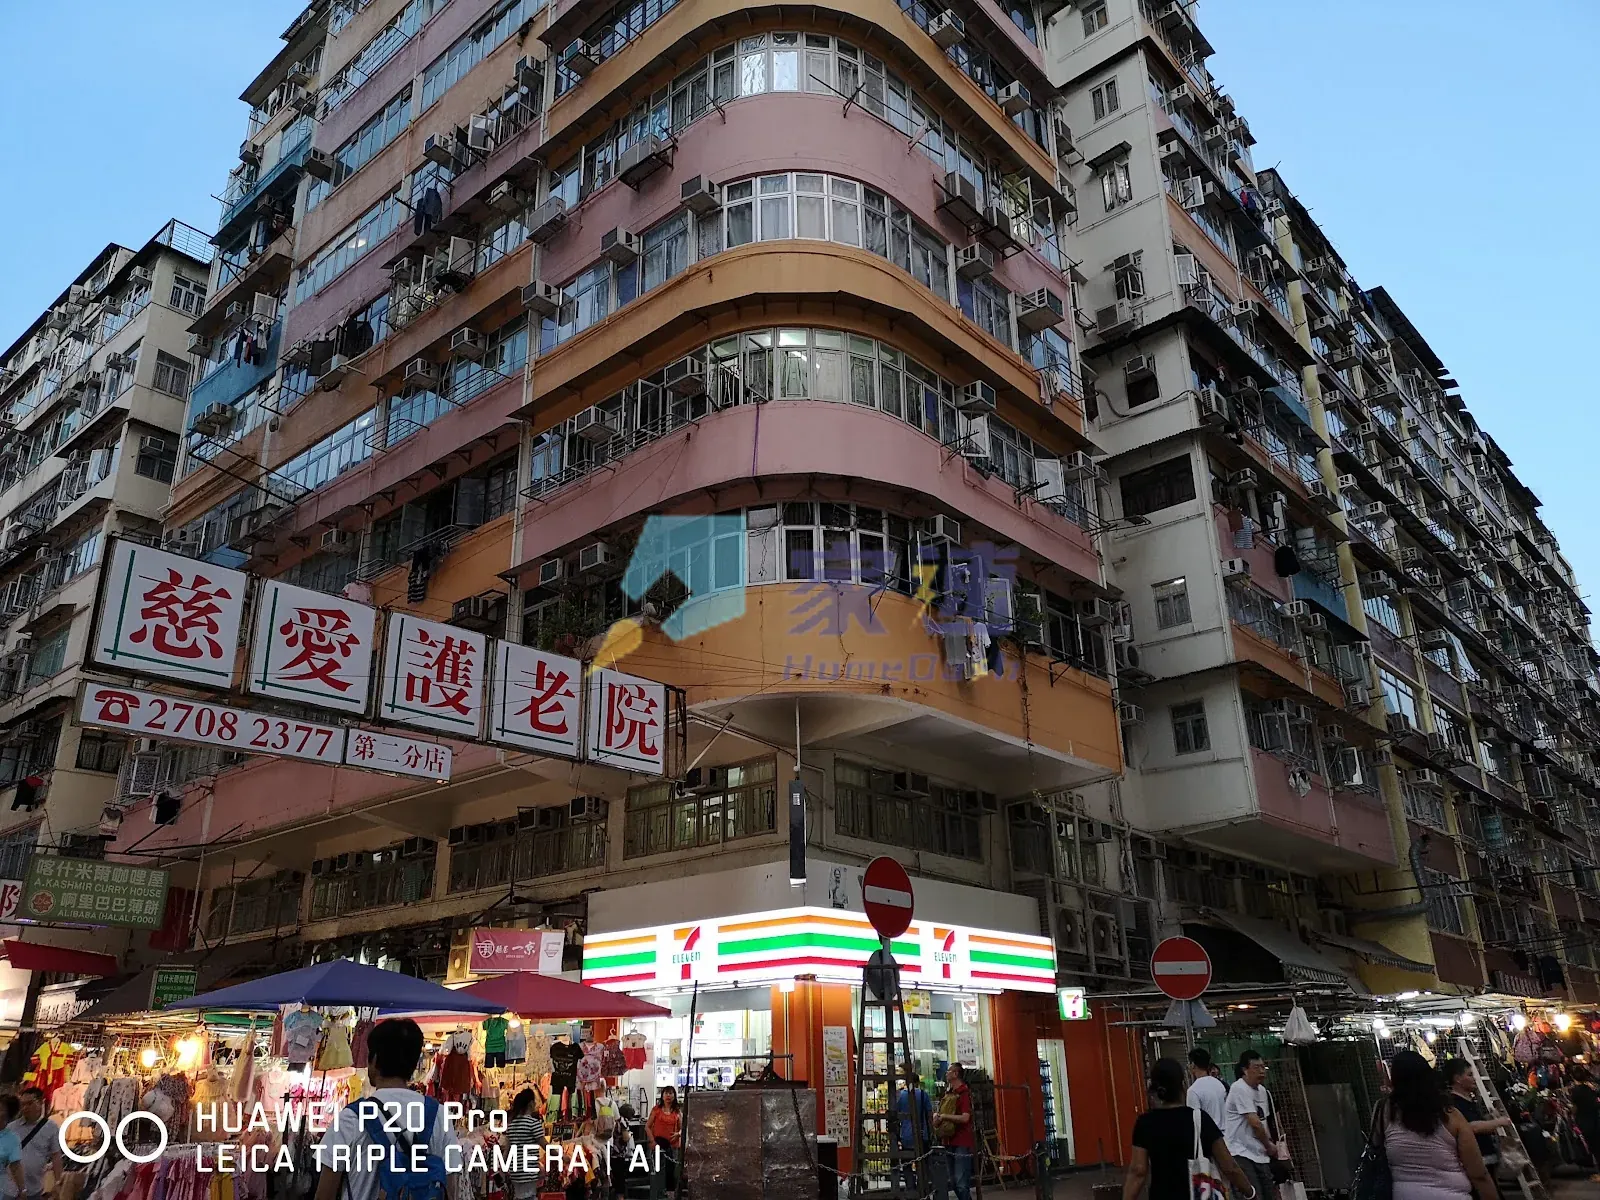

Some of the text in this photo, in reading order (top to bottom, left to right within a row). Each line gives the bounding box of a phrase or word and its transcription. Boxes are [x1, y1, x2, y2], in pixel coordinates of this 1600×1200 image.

[128, 567, 659, 758] 慈愛護老院
[146, 698, 335, 758] 2708 2377
[353, 733, 447, 774] 第二分店
[34, 878, 162, 898] A.KASHMIR CURRY HOUSE
[36, 859, 165, 888] 喀什米爾咖哩屋
[57, 910, 97, 920] ALIBABA
[131, 916, 157, 924] FOOD)
[60, 892, 160, 916] 啊里巴巴薄餅
[674, 926, 701, 980] 7
[933, 927, 955, 979] 7
